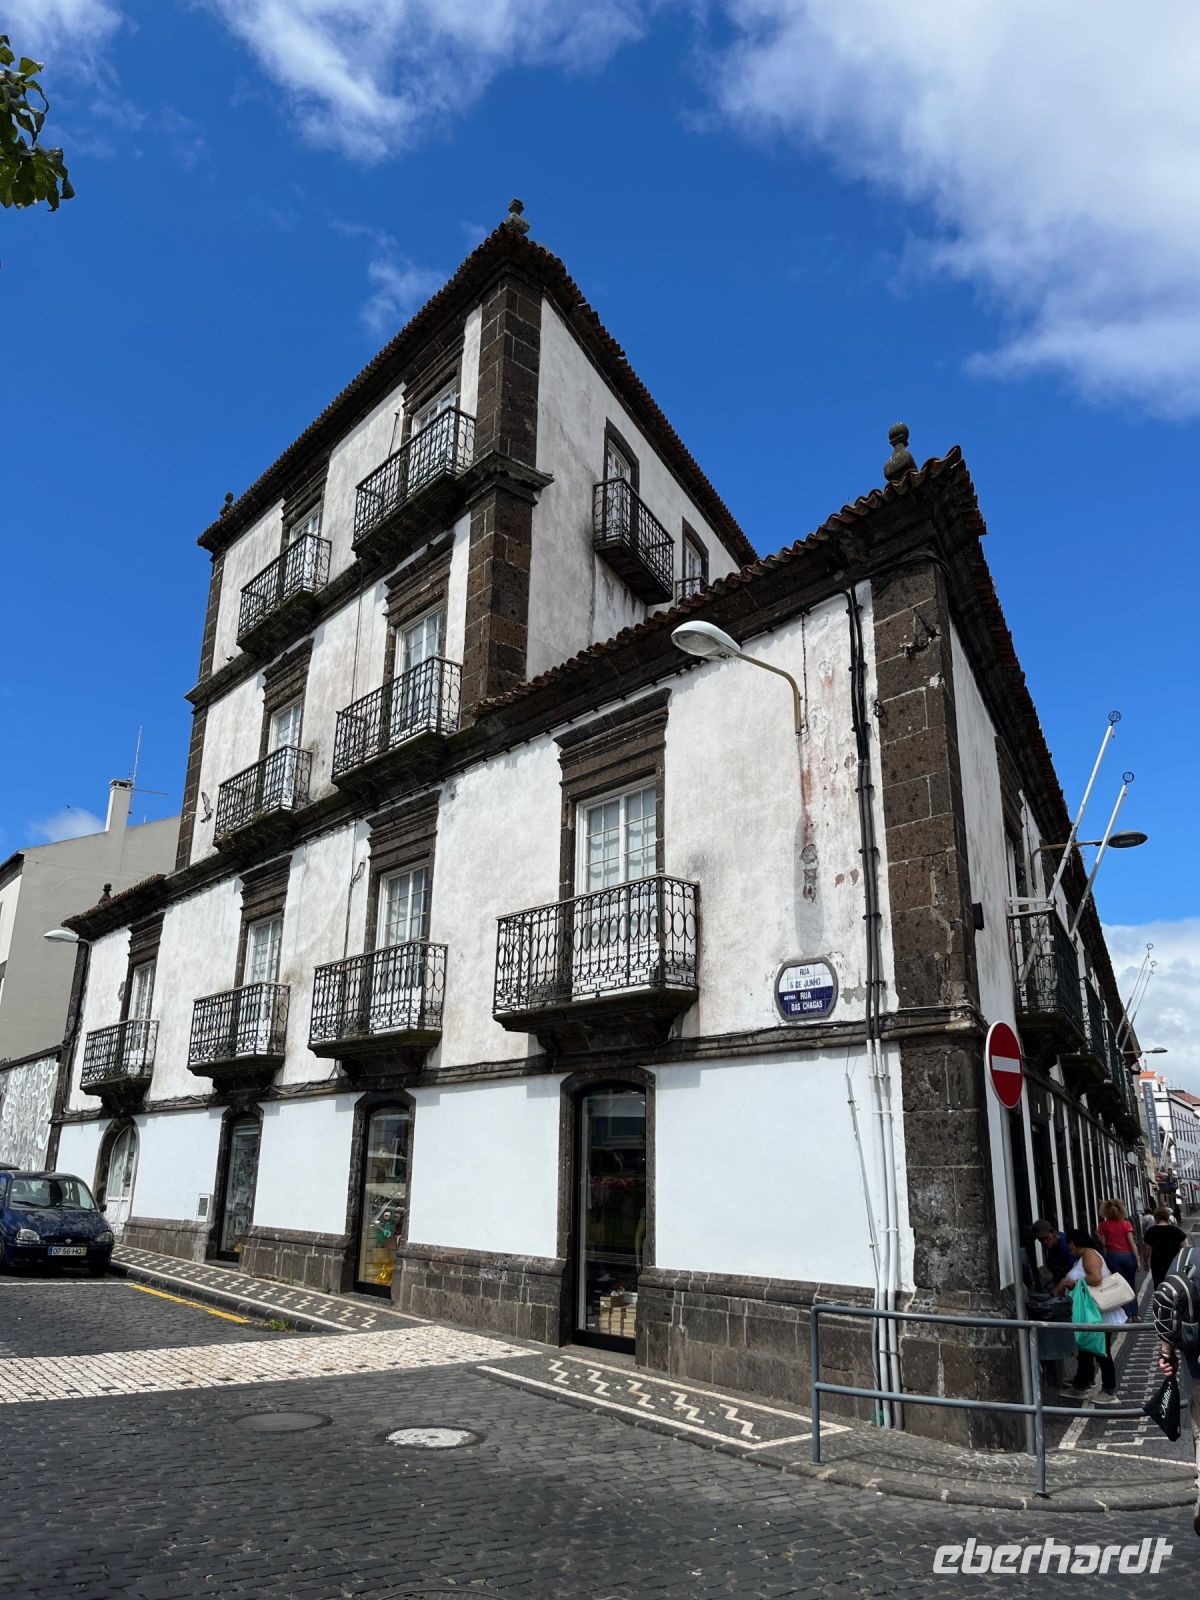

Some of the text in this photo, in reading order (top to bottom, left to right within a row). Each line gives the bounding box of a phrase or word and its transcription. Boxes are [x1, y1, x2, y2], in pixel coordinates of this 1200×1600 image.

[800, 968, 810, 976] RUA
[796, 981, 802, 989] DE
[804, 978, 821, 987] JUNHO
[800, 991, 812, 1000] RUA
[791, 1001, 823, 1011] DAS CHAGAS
[1148, 1111, 1159, 1154] CRISTAL
